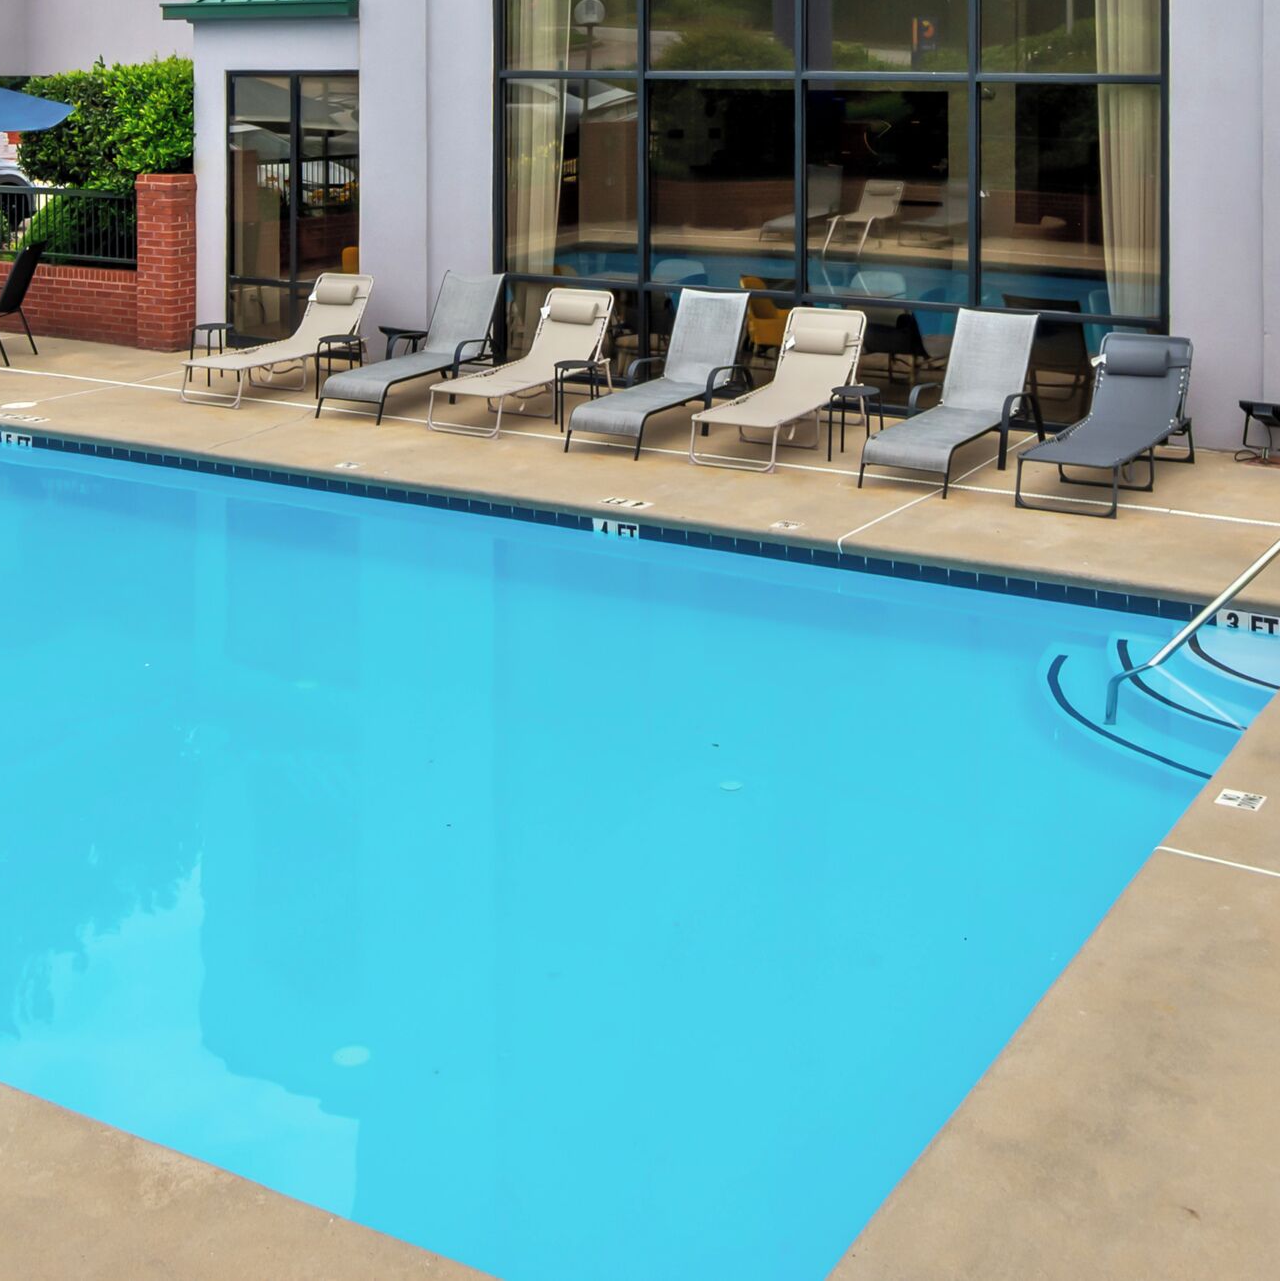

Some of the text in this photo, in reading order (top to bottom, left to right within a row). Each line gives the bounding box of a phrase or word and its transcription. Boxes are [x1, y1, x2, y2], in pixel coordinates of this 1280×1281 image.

[17, 435, 31, 447] FT
[618, 524, 637, 538] FT
[1226, 612, 1279, 635] 3 FT
